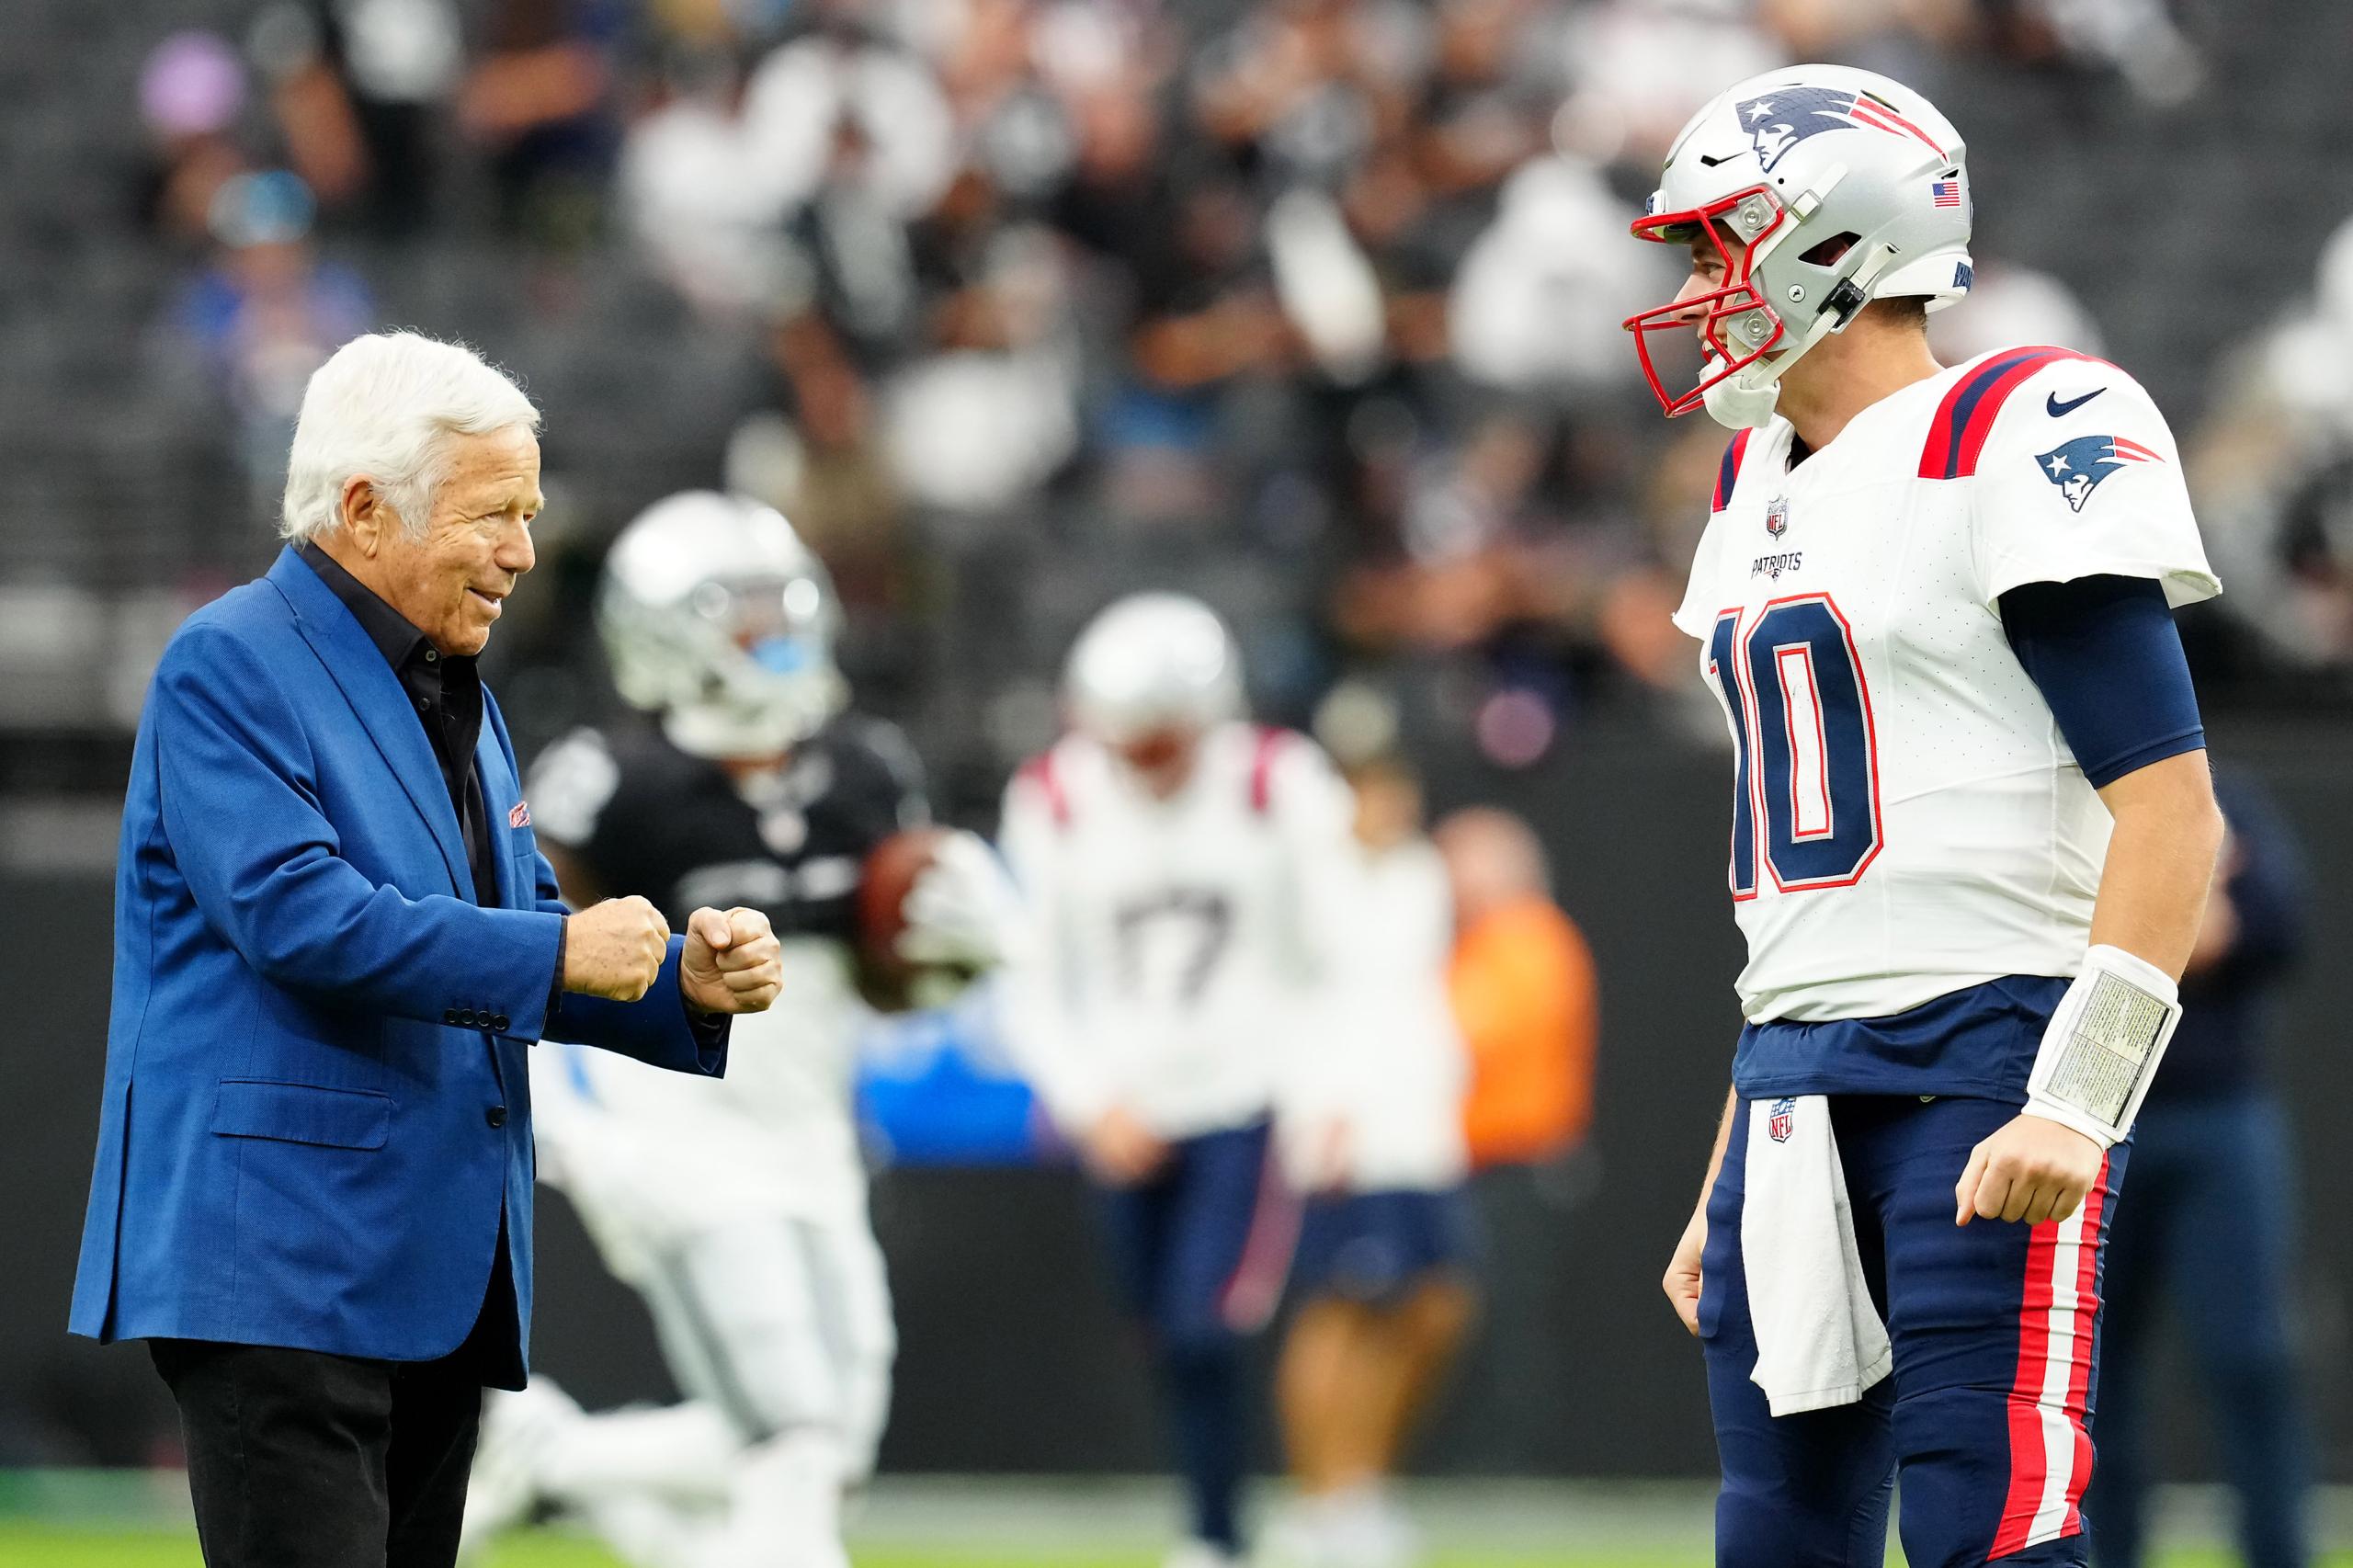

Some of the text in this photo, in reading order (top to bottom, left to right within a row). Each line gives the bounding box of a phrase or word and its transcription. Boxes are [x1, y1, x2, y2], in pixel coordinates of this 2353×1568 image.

[1768, 514, 1784, 531] NFL
[1750, 551, 1802, 580] PATRIOTS
[1710, 592, 1883, 902] 10
[1770, 1114, 1791, 1139] NFL
